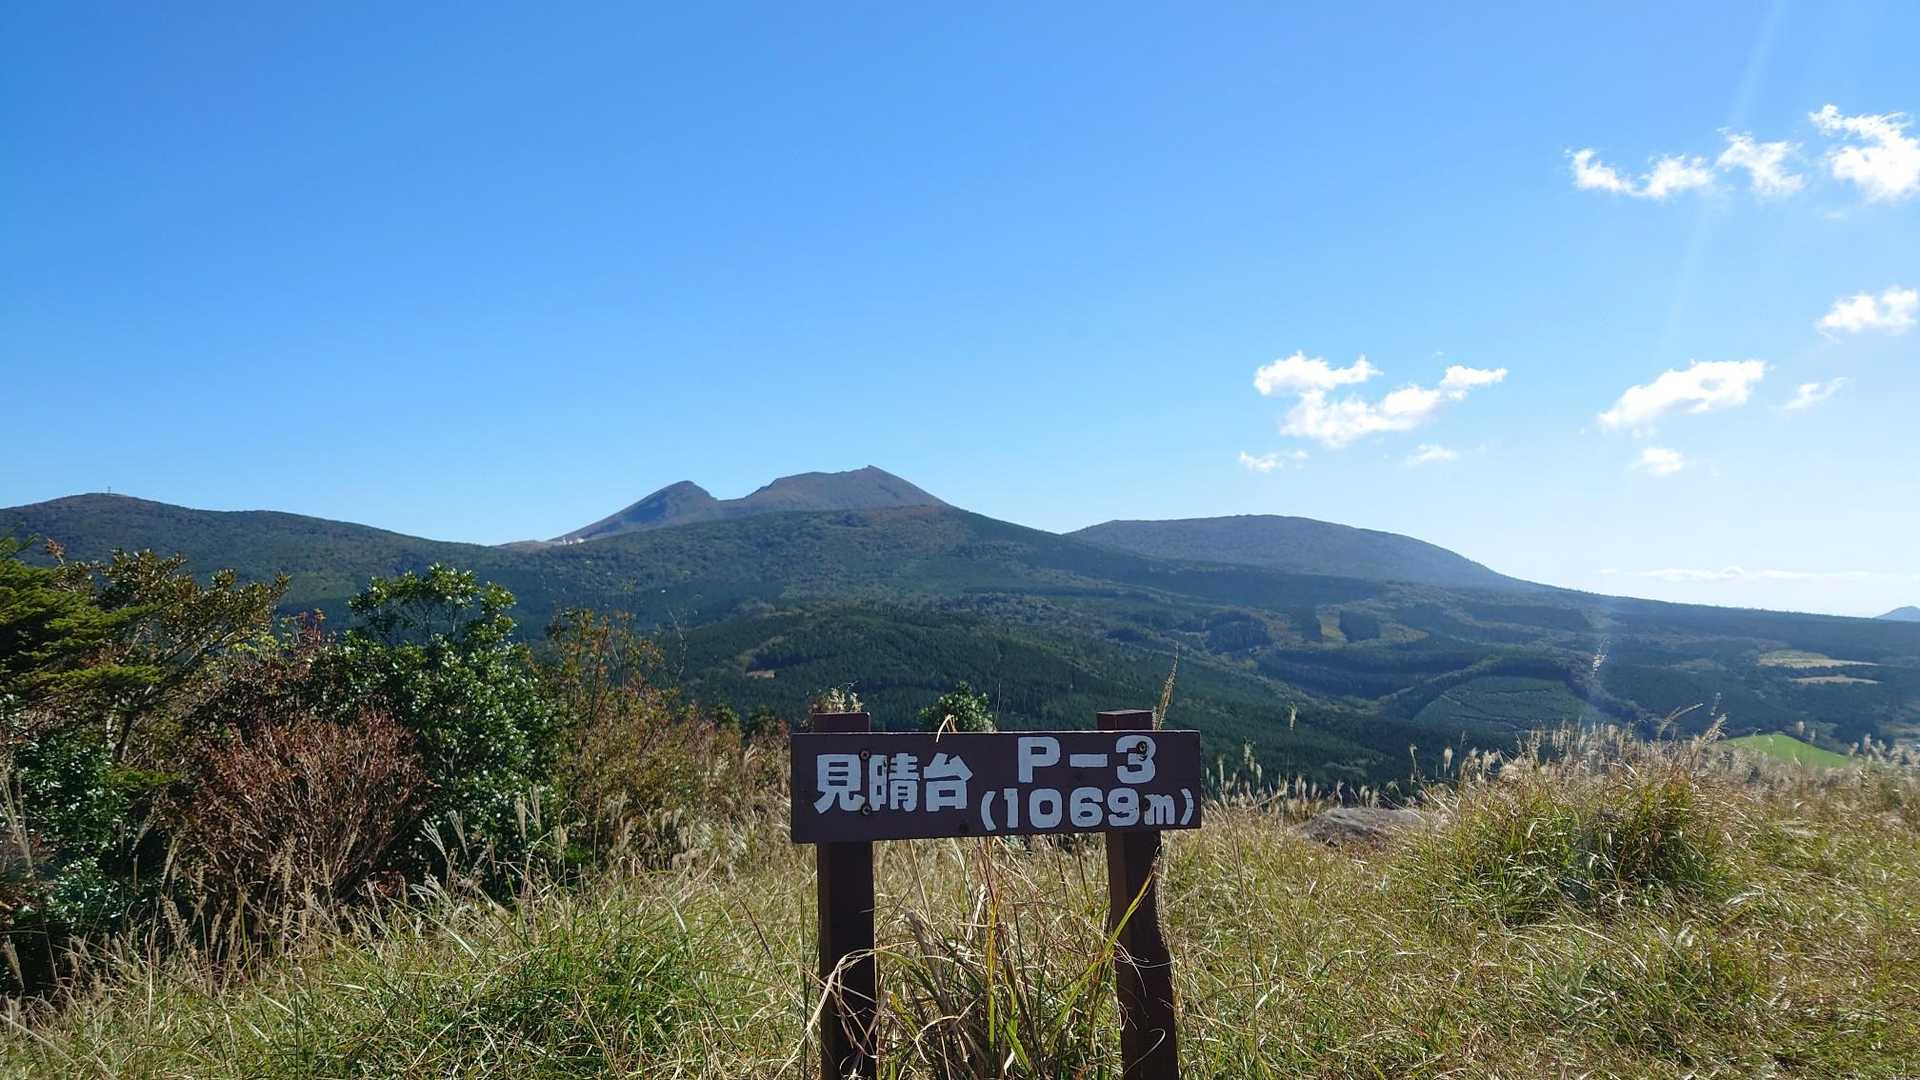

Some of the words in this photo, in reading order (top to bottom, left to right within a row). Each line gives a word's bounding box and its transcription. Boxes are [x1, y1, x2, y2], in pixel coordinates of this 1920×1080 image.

[814, 753, 973, 813] 見晴台
[1017, 734, 1157, 785] P-3
[980, 788, 1193, 831] (1069m)
